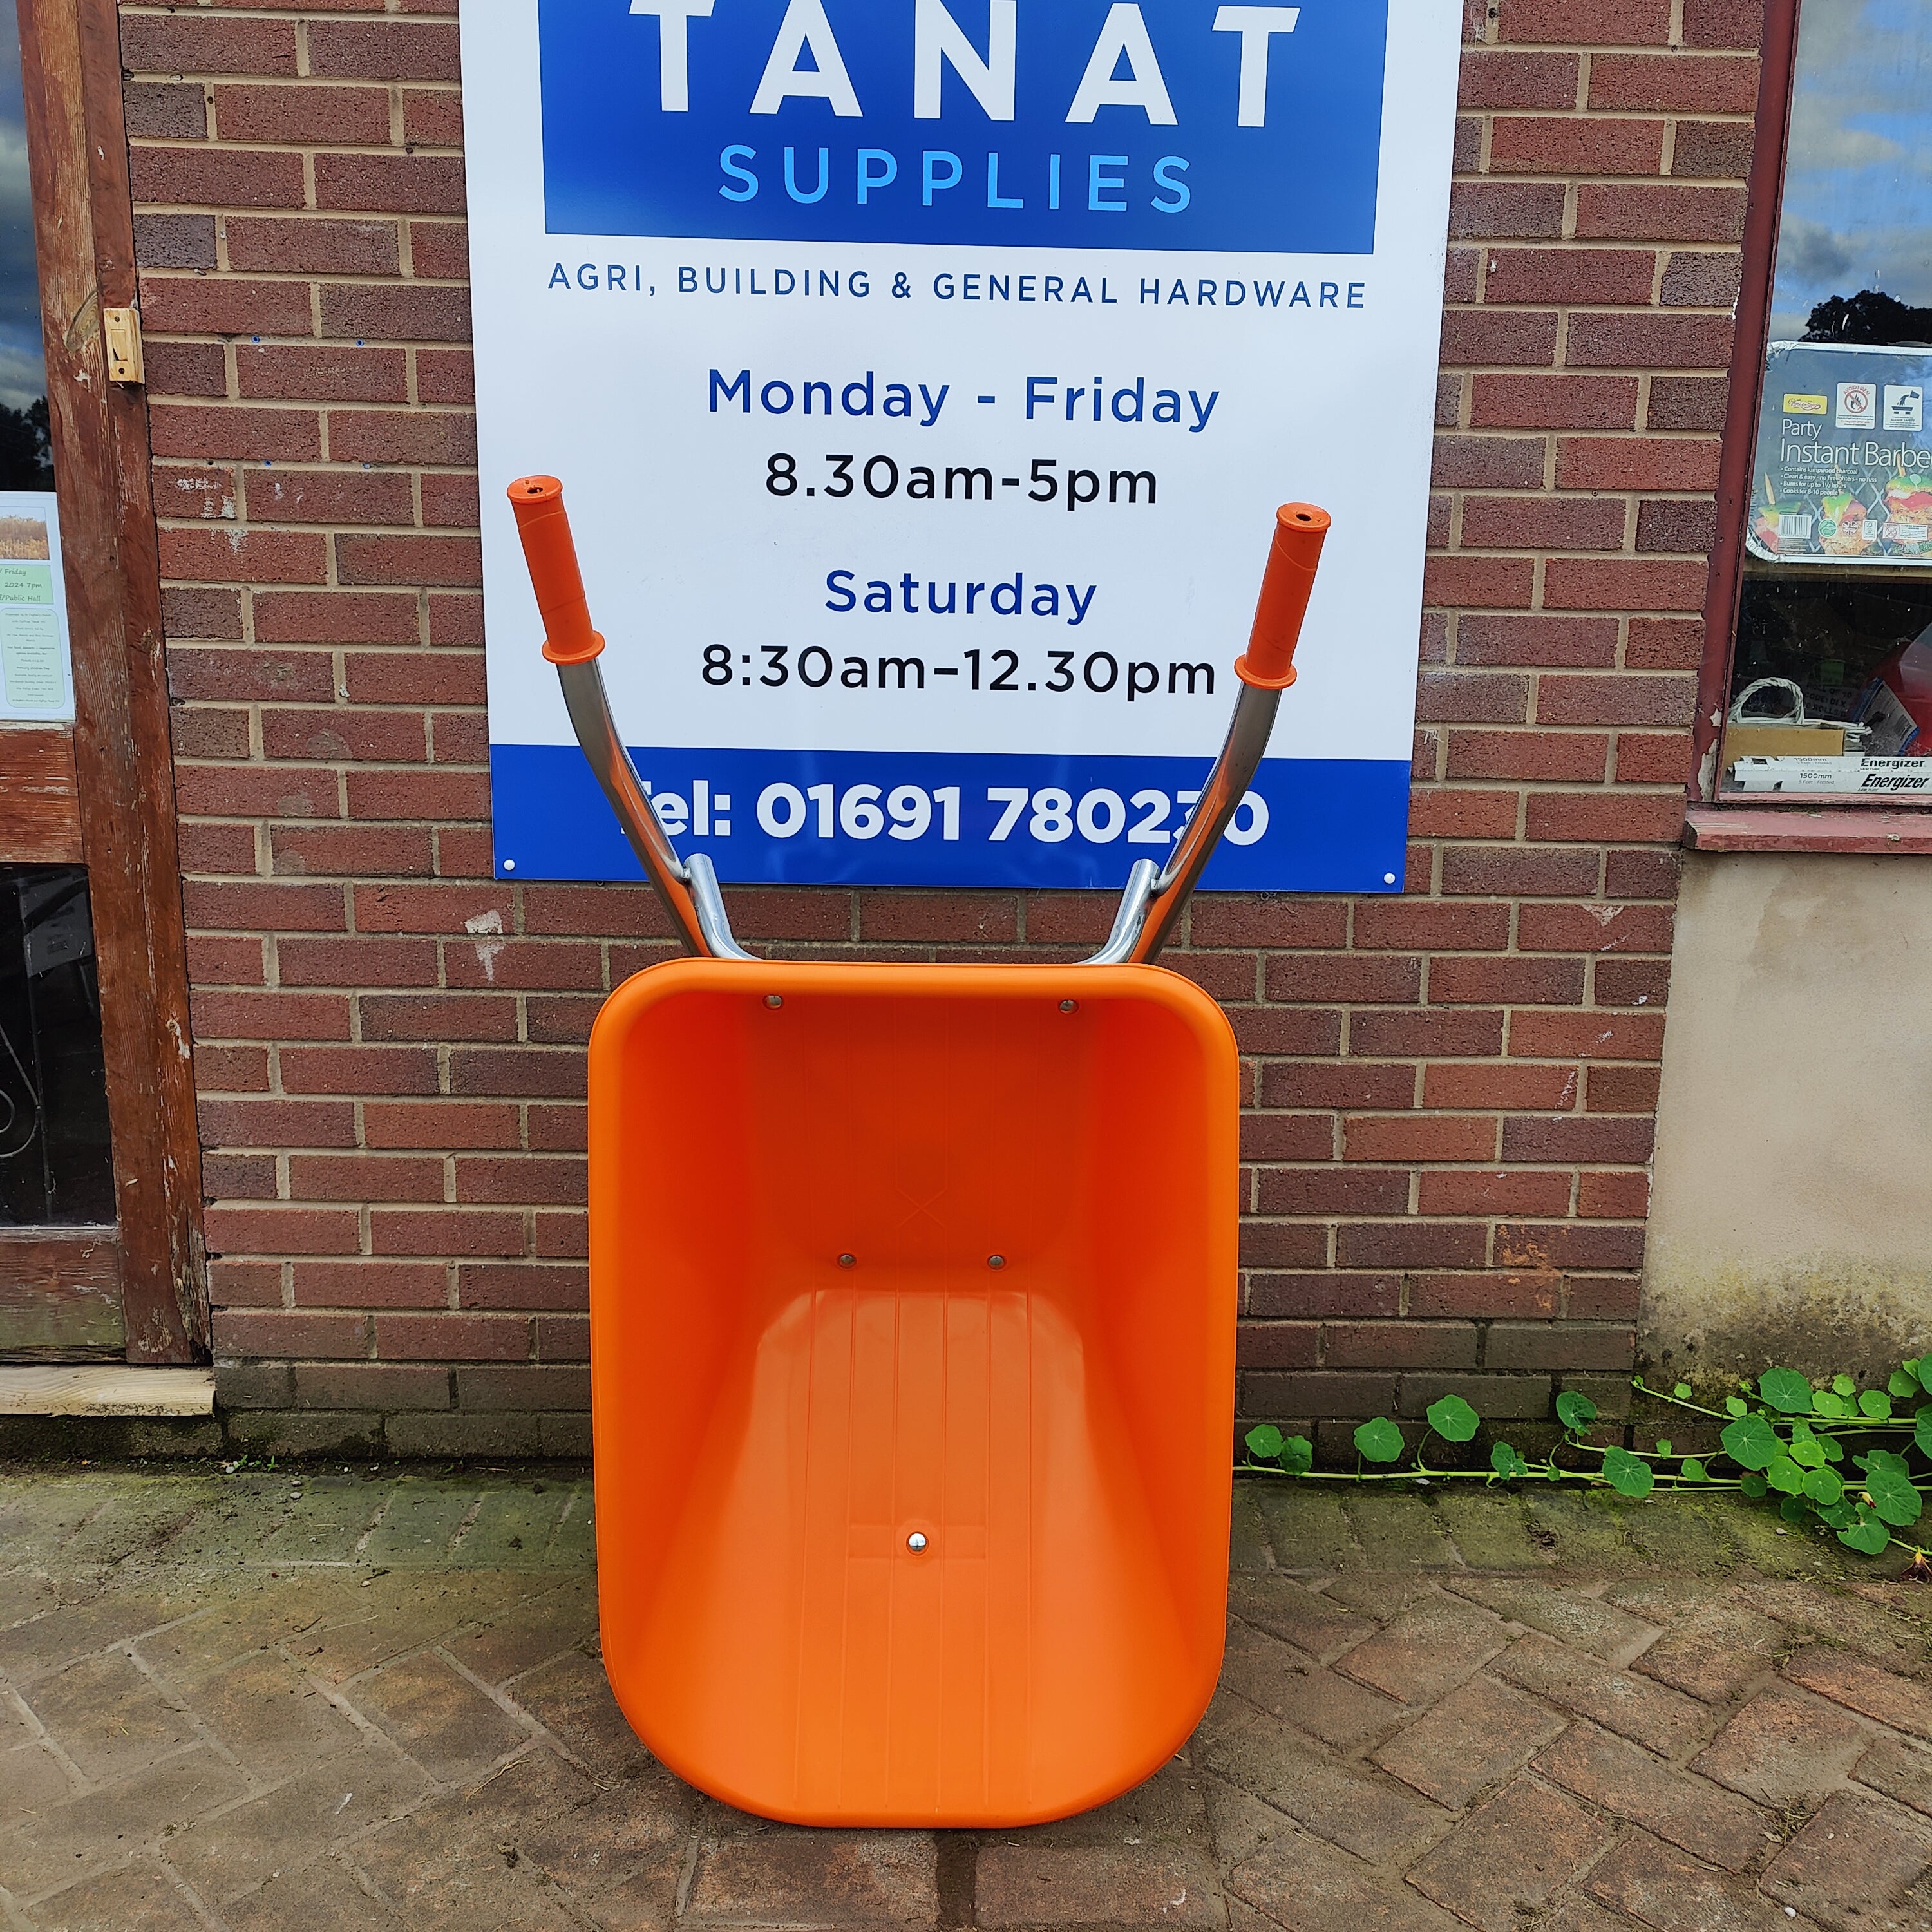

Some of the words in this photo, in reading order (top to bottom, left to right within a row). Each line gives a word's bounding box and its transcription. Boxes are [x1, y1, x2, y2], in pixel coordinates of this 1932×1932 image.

[630, 0, 1300, 127] TANAT
[719, 145, 1191, 213] SUPPLIES
[548, 263, 655, 297] AGRI,
[678, 266, 869, 298] BUILDING
[891, 272, 911, 299] &
[933, 272, 1117, 303] GENERAL
[1140, 278, 1365, 308] HARDWARE
[709, 368, 950, 427] Monday
[977, 395, 996, 404] -
[1026, 376, 1220, 433] Friday
[1843, 385, 1857, 395] AVOID
[1782, 418, 1823, 441] Party
[1781, 438, 1860, 465] Instant
[1865, 441, 1932, 468] Barbe
[766, 452, 1157, 511] 8.30am-5pm
[5, 568, 26, 576] Friday
[26, 582, 43, 591] 7pm
[824, 569, 1097, 625] Saturday
[702, 643, 1215, 702] 8:30am-12.30pm
[1861, 758, 1926, 770] Energizer
[1861, 773, 1930, 791] Energizer
[621, 779, 731, 837] el:
[757, 782, 960, 840] 01691
